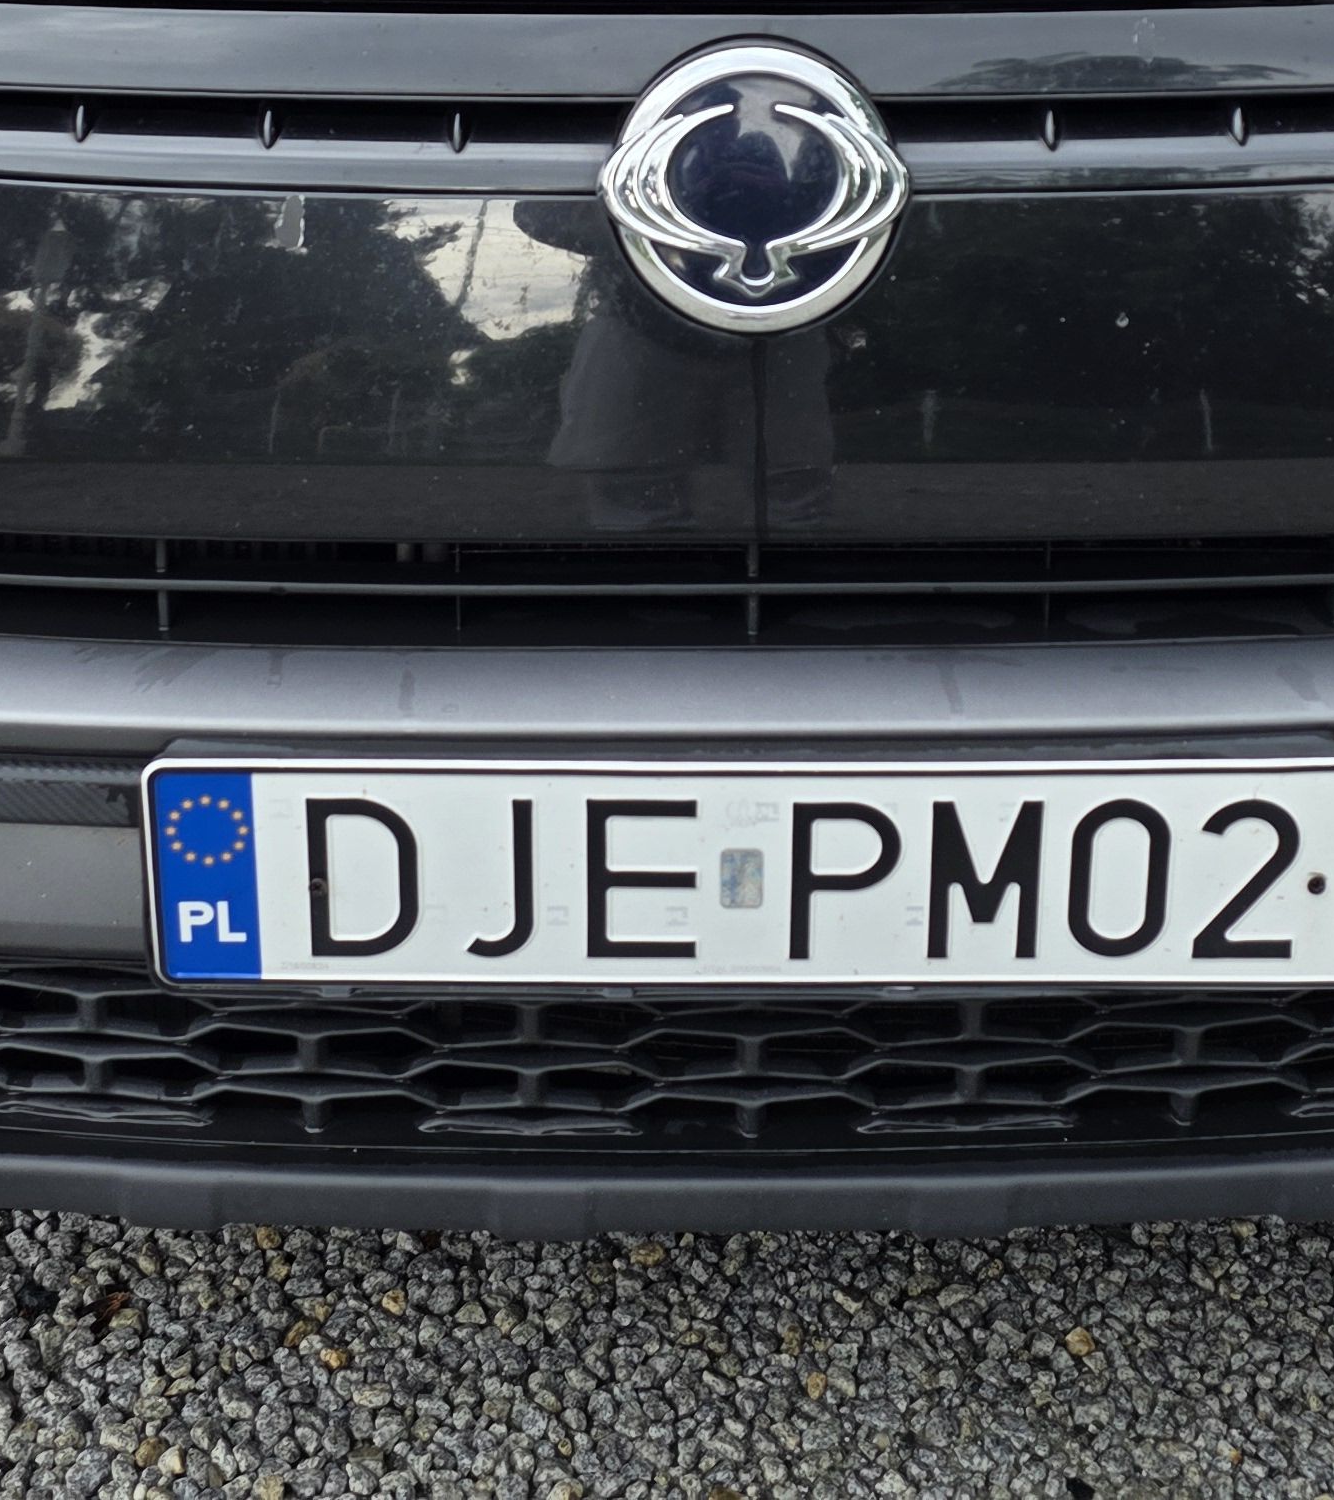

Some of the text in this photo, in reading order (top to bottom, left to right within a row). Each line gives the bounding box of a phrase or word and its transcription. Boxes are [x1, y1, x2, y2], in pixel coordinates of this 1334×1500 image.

[178, 900, 247, 943] PL
[305, 797, 1301, 960] DJE PM02
